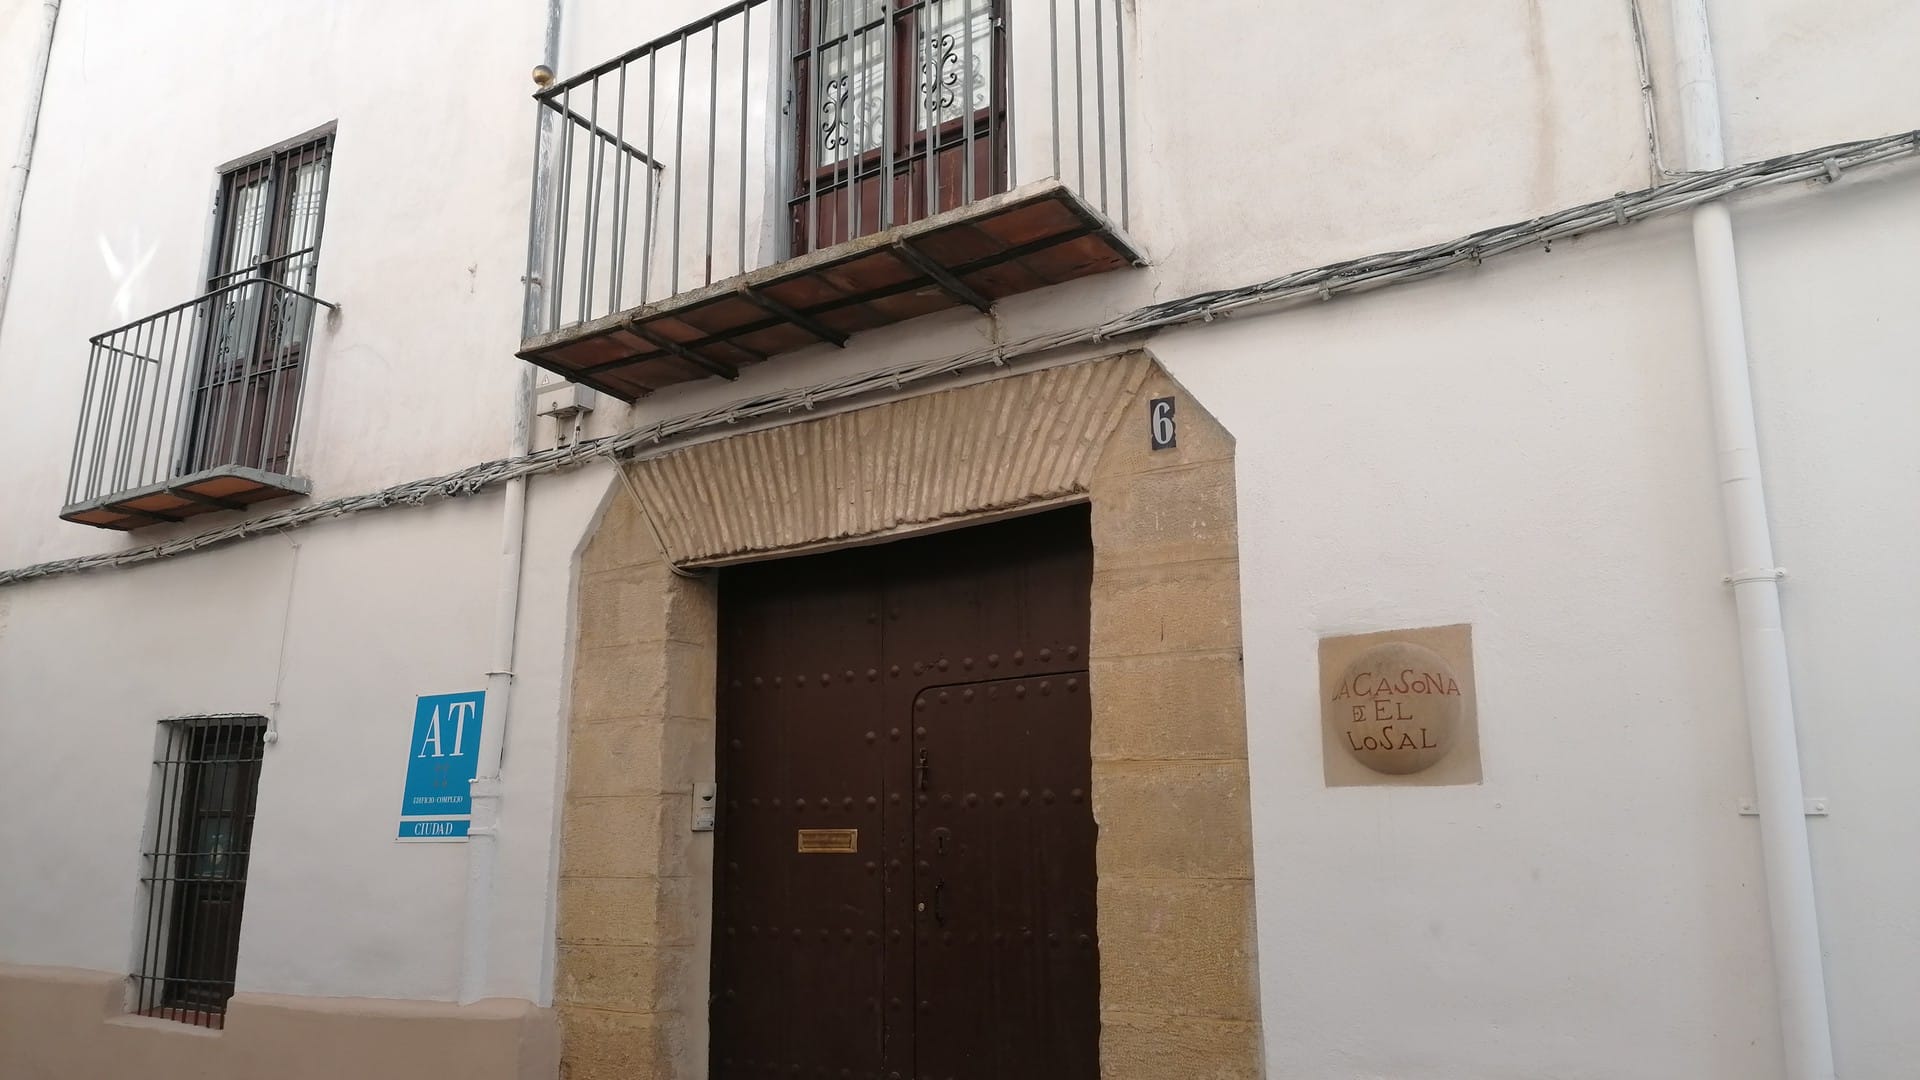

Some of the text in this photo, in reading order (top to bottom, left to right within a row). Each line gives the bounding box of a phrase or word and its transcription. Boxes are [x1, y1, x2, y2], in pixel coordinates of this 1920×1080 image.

[1152, 402, 1174, 445] 6
[1353, 669, 1461, 697] CASONA
[1375, 699, 1413, 722] EL
[418, 701, 476, 758] AT
[1346, 725, 1437, 751] LOSAL
[414, 822, 454, 836] CIUDAD
